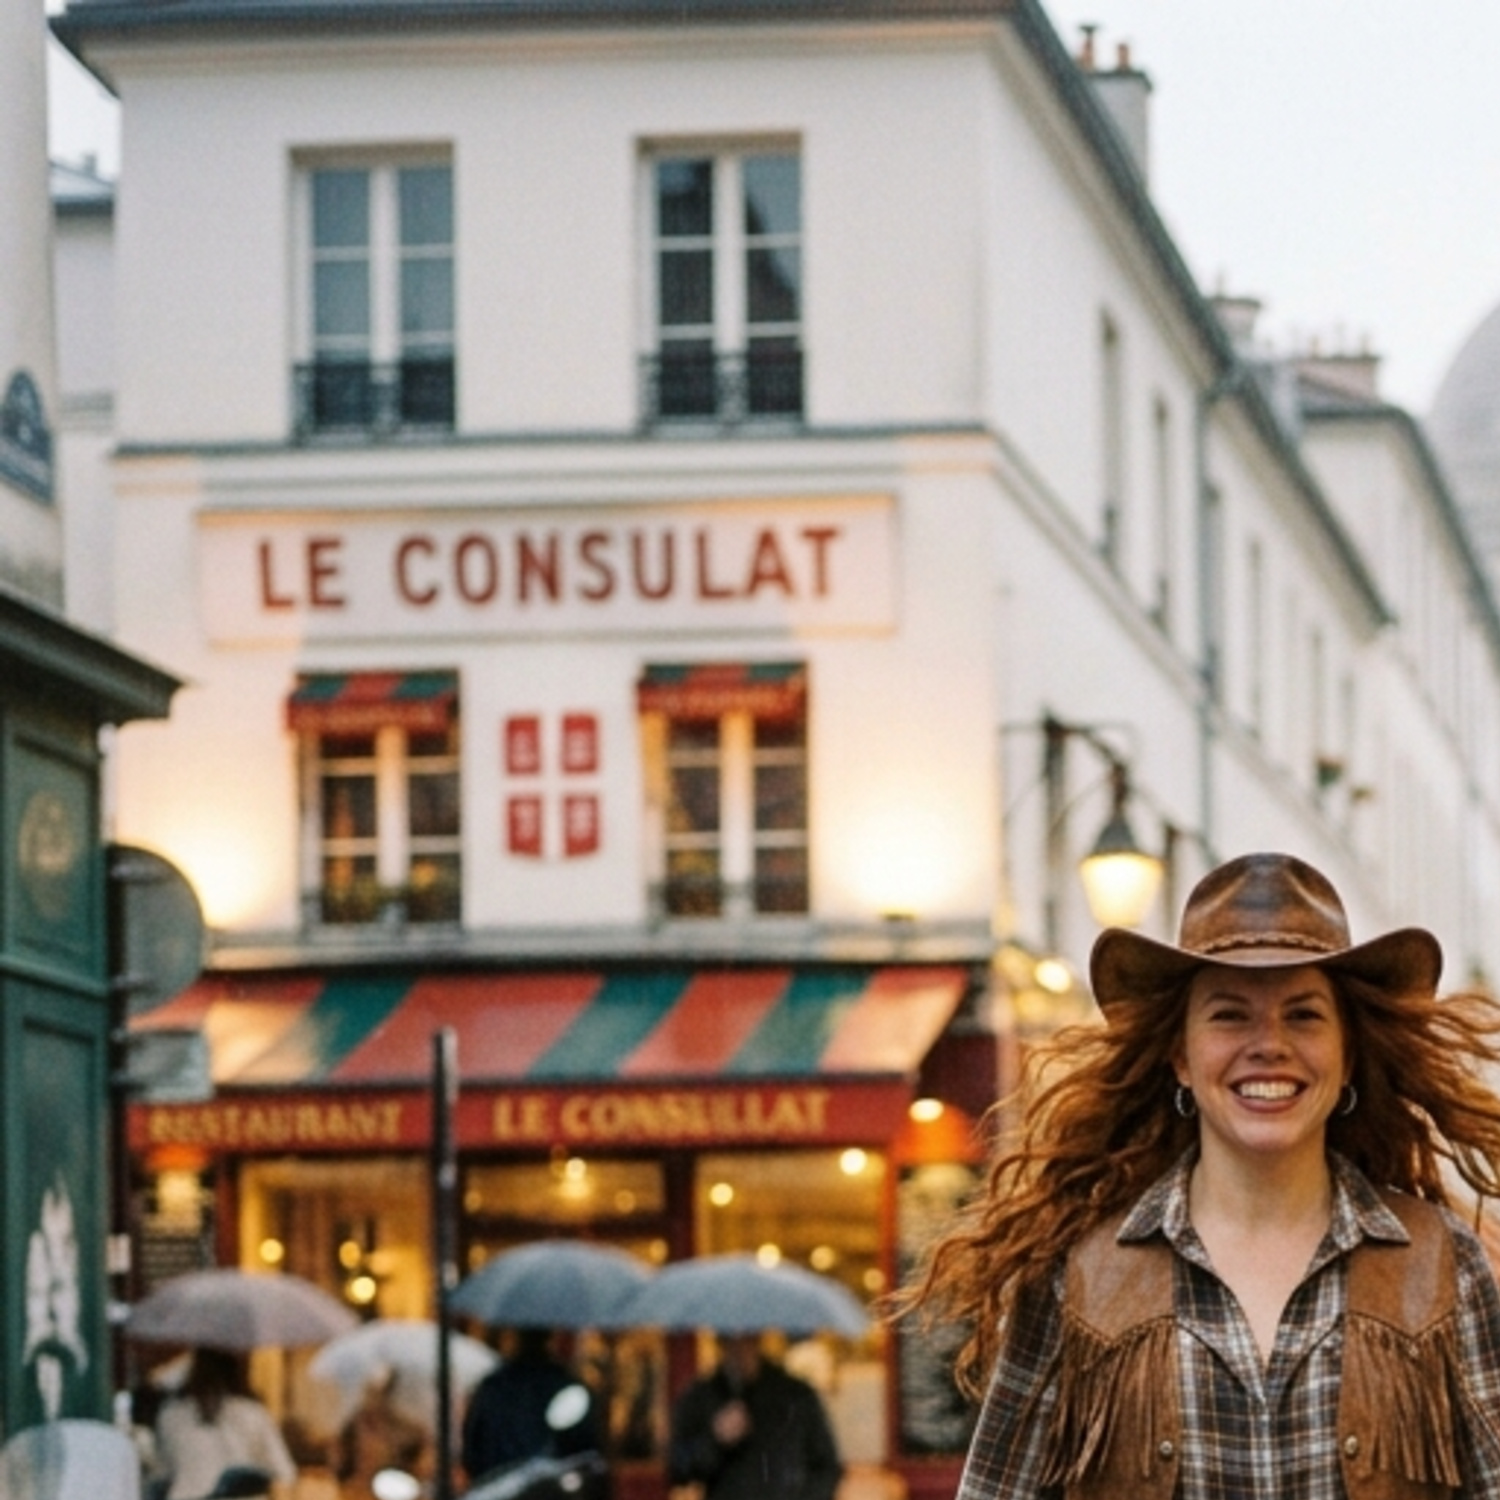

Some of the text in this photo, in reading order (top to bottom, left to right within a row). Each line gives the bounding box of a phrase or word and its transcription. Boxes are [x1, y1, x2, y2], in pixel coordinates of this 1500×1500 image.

[258, 528, 839, 609] LE CONSULAT
[493, 1097, 556, 1141] LE
